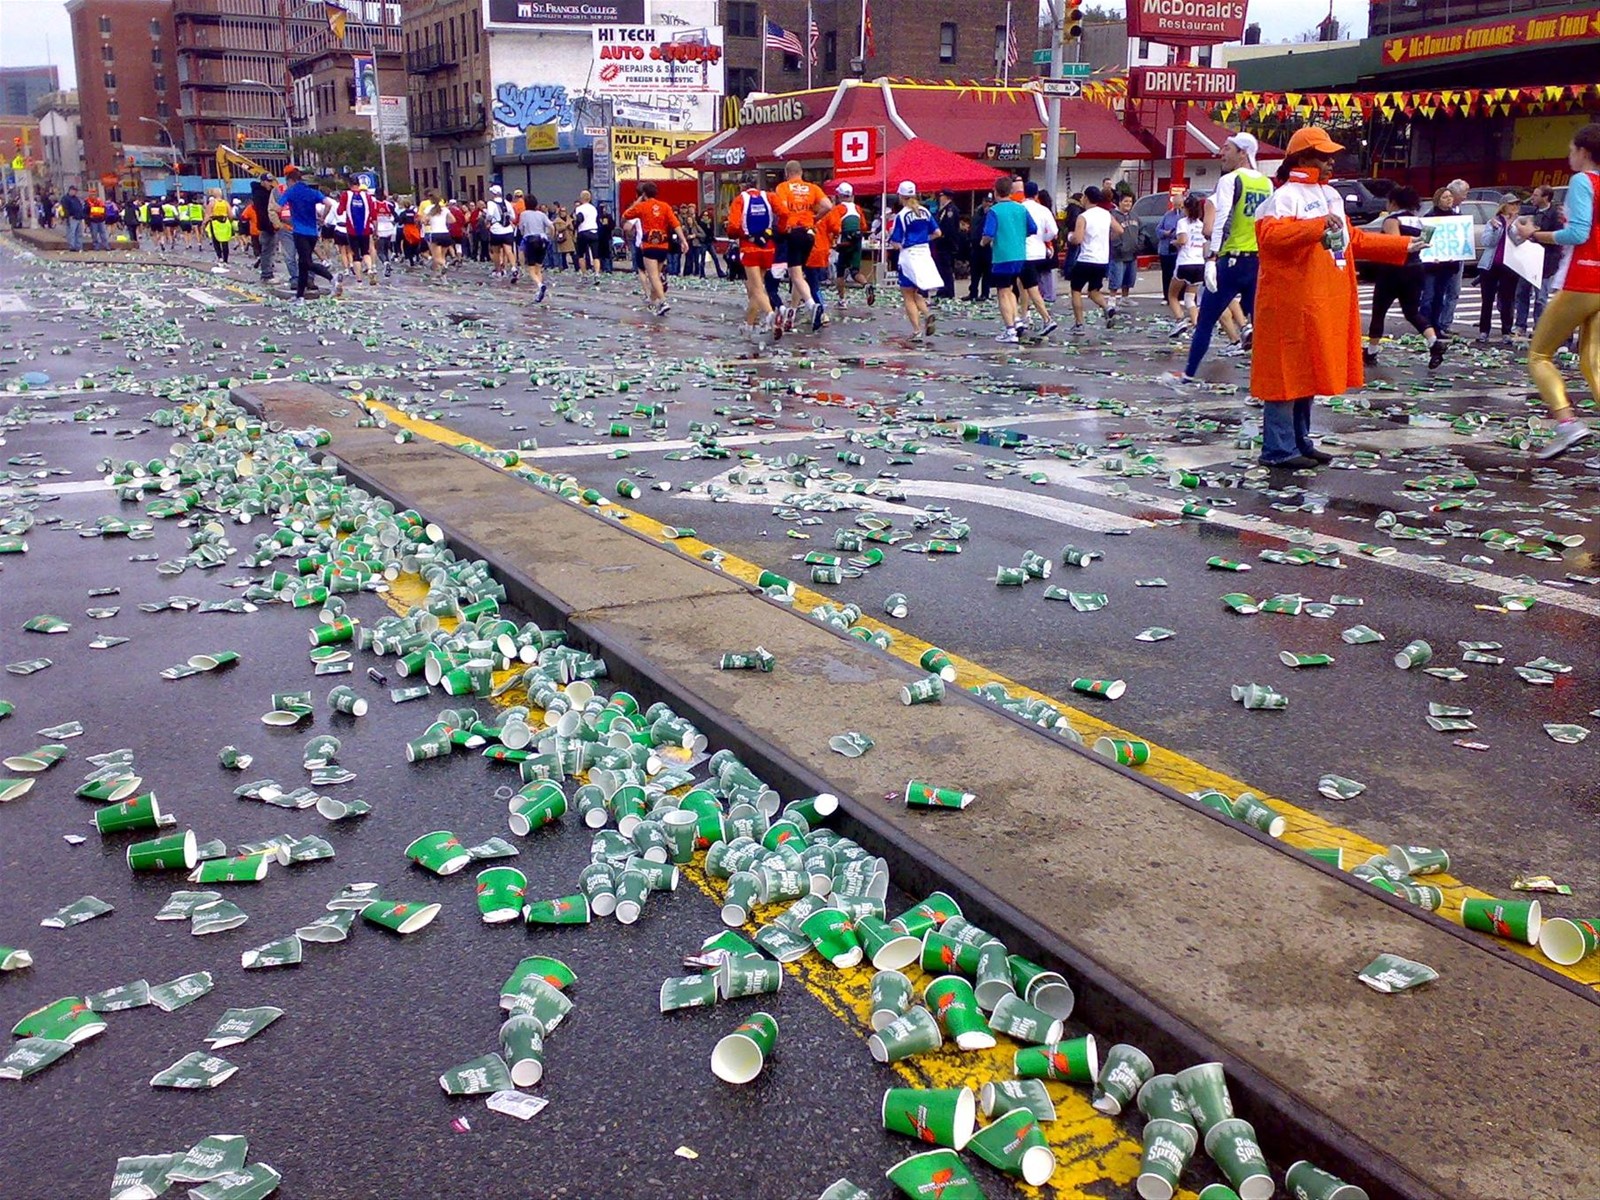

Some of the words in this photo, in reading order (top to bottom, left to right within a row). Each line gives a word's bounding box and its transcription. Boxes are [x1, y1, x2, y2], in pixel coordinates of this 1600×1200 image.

[580, 4, 618, 15] COLLEGE
[1143, 0, 1244, 19] McDonald's
[1158, 18, 1225, 32] Restaurant
[1465, 24, 1516, 48] ENTRANCE
[1526, 19, 1558, 41] DRIVE
[1560, 15, 1589, 36] THRU
[599, 28, 614, 41] HI
[619, 29, 656, 41] TECH
[600, 45, 645, 60] AUTO
[620, 64, 654, 73] REPAIRS
[656, 65, 662, 73] &
[664, 65, 699, 74] SERVICE
[1145, 71, 1236, 93] DRIVE-THRU
[615, 151, 621, 160] 4
[114, 1170, 144, 1180] oland
[112, 1176, 143, 1189] pring
